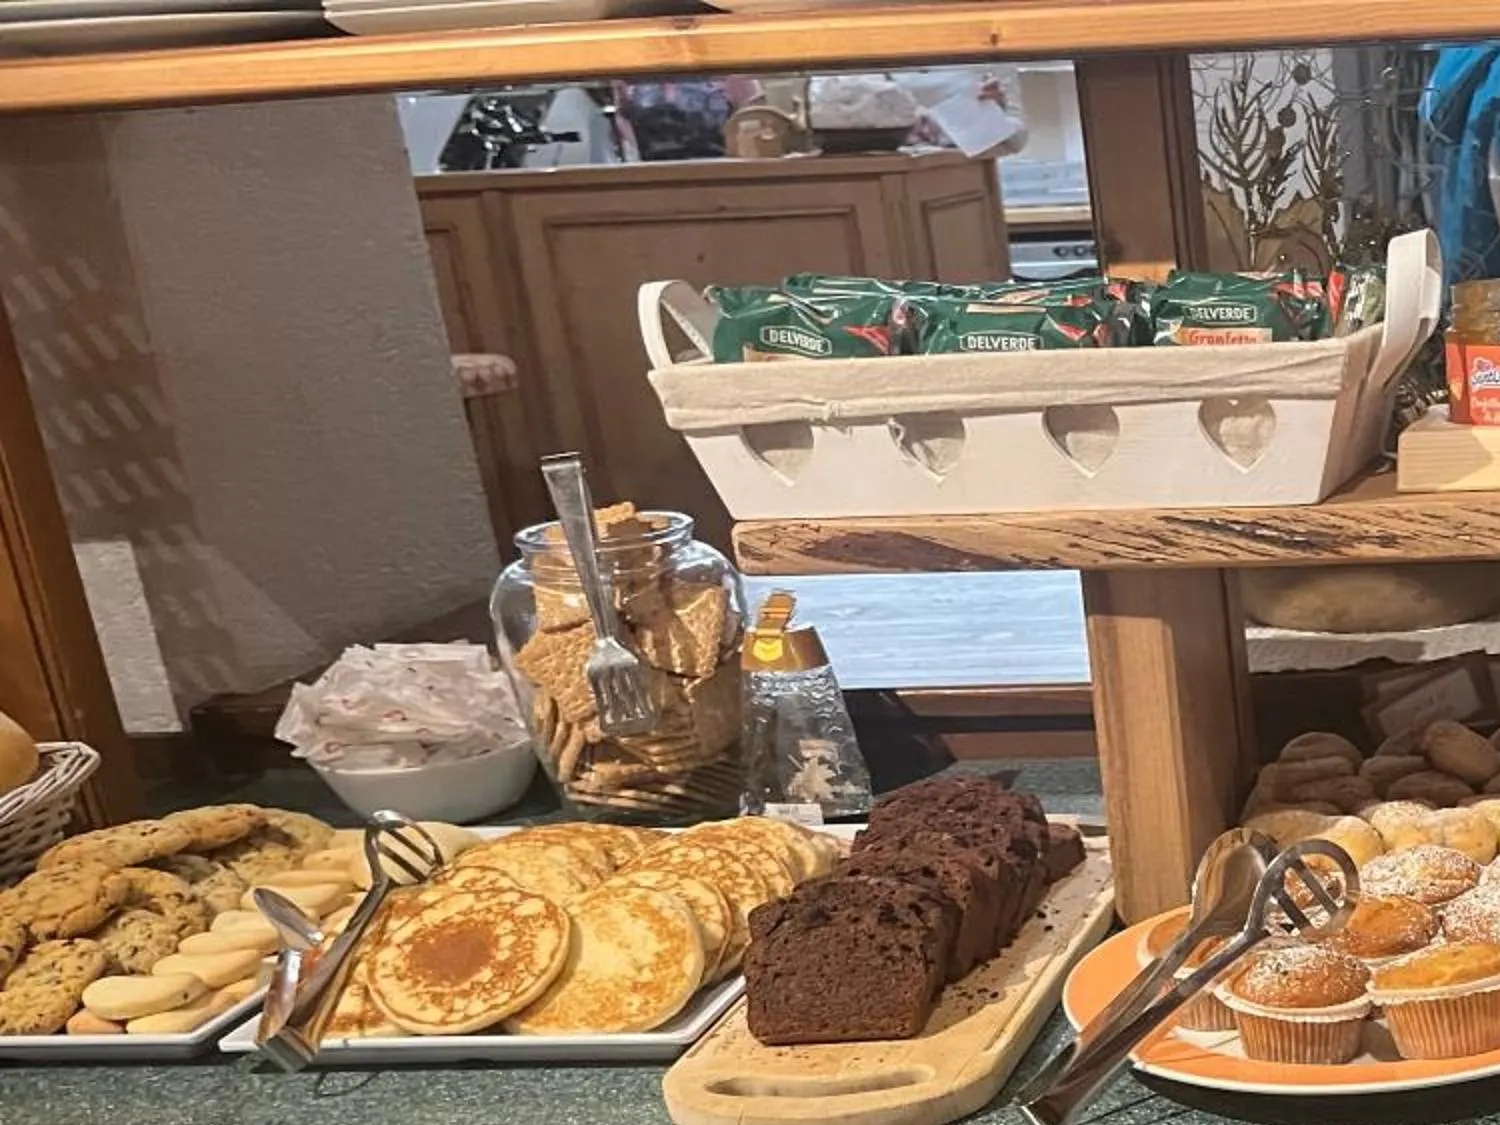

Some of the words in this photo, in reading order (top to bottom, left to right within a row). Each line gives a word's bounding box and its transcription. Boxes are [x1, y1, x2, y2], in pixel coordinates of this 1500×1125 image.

[1189, 307, 1251, 321] DELVERDE
[768, 329, 825, 353] DELVERDE
[966, 335, 1035, 351] DELVERDE
